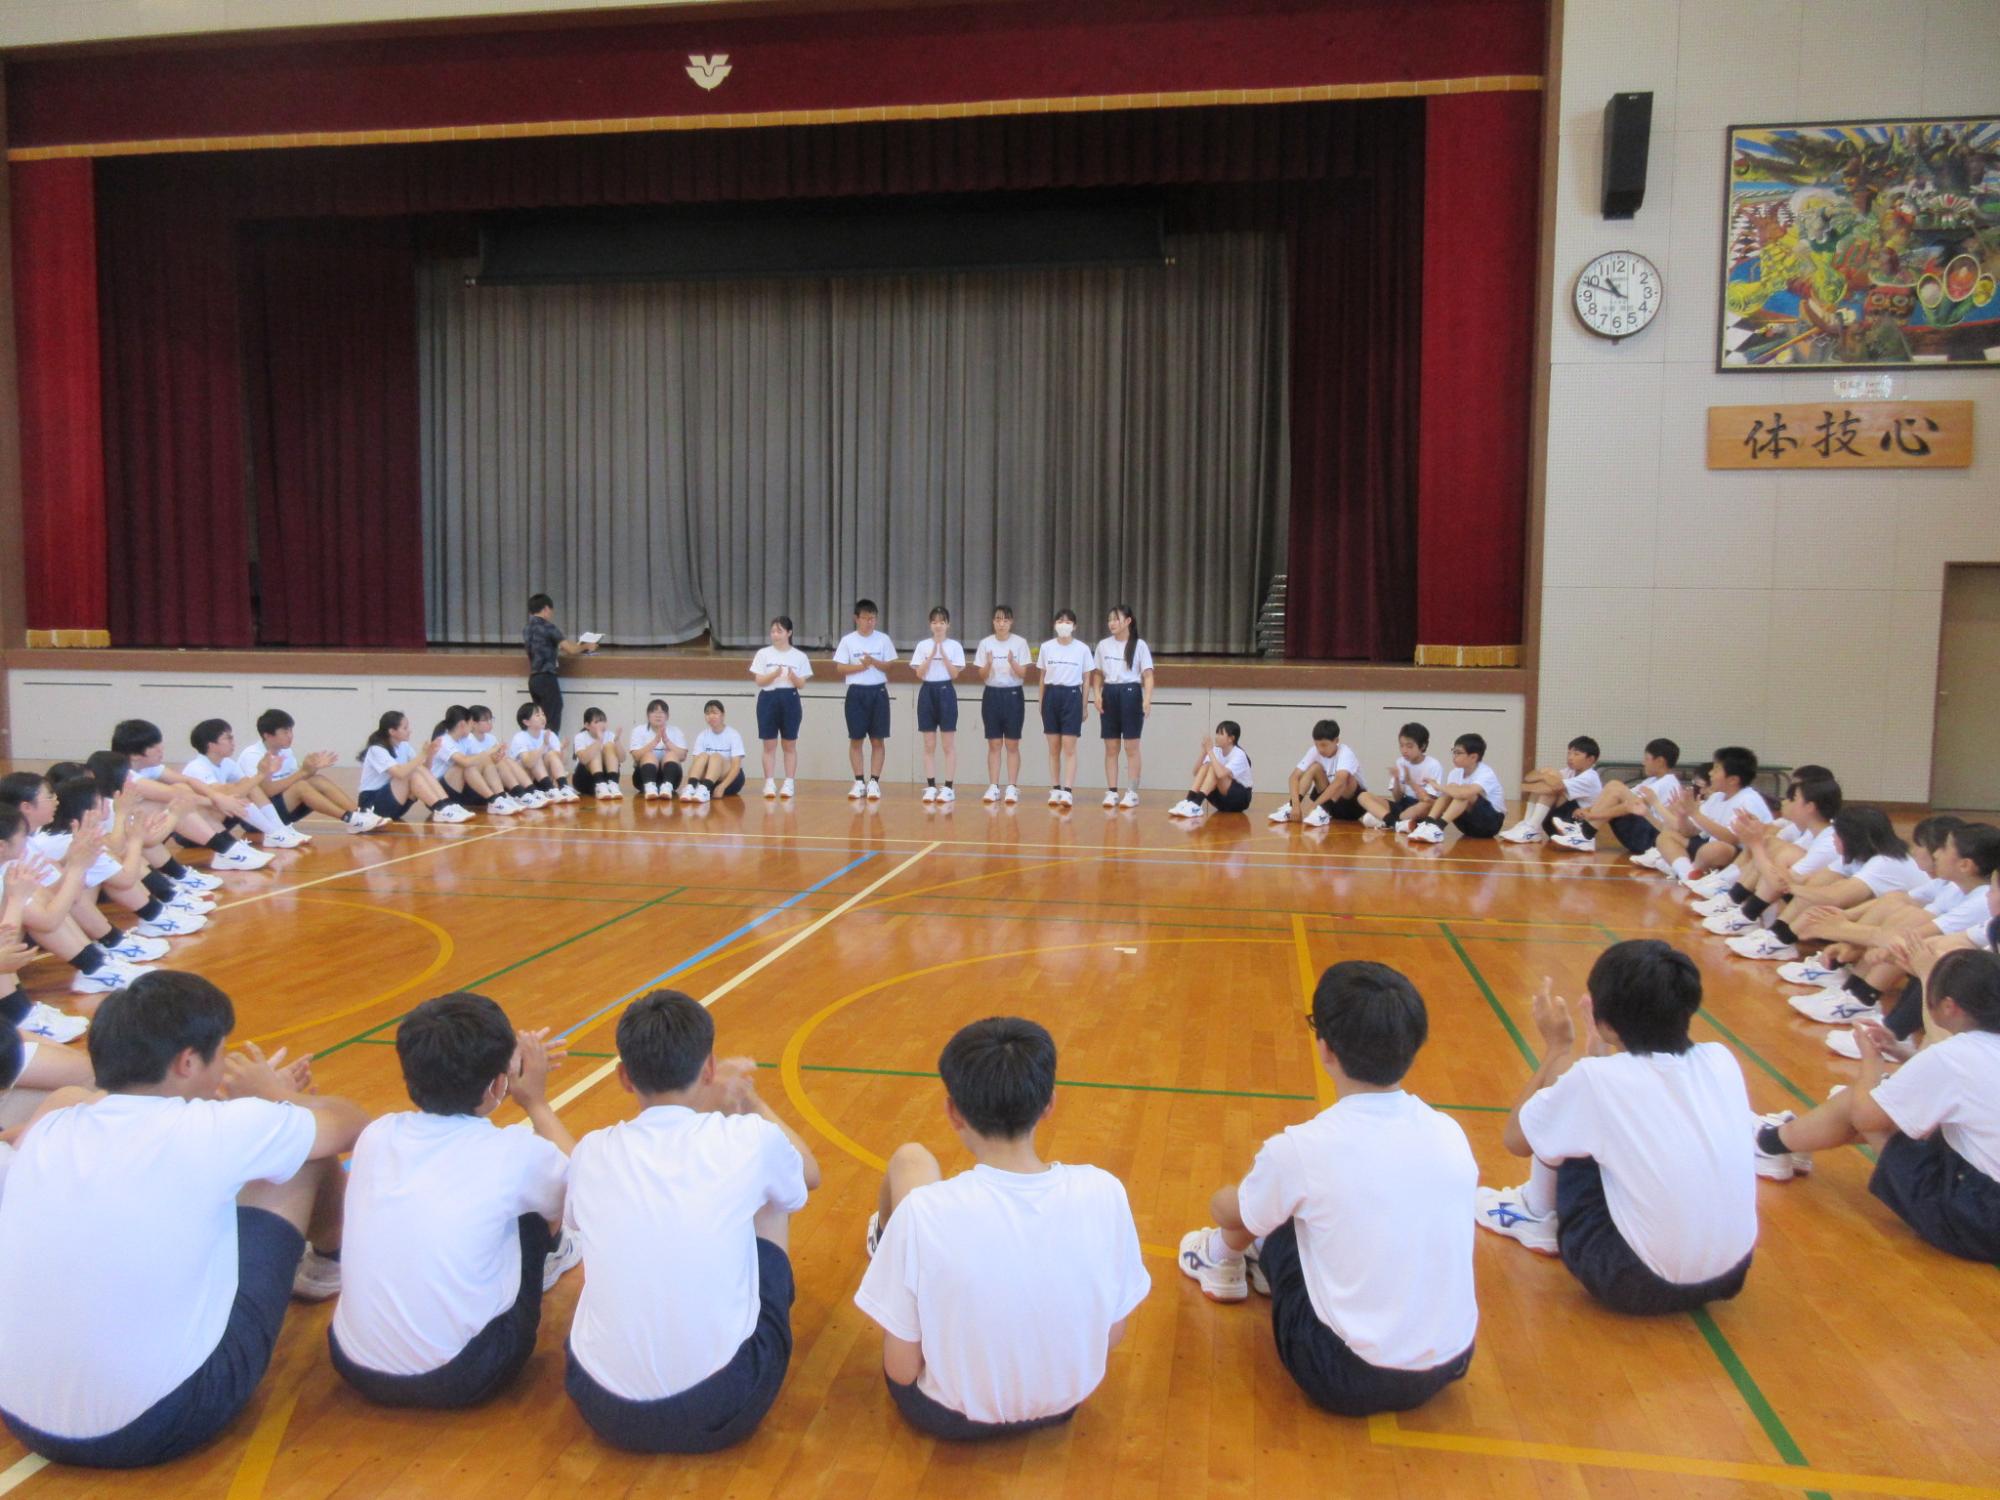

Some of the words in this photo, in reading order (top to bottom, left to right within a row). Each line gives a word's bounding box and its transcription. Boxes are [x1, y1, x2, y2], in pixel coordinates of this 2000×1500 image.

[1600, 264, 1609, 276] 11
[1612, 260, 1626, 273] 12
[1587, 275, 1600, 288] 10
[1640, 272, 1648, 285] 2
[1583, 289, 1593, 303] 9
[1643, 286, 1653, 300] 3
[1588, 303, 1597, 316] 8
[1638, 301, 1648, 313] 4
[1600, 313, 1608, 326] 7
[1612, 316, 1622, 329] 6
[1627, 312, 1637, 324] 5
